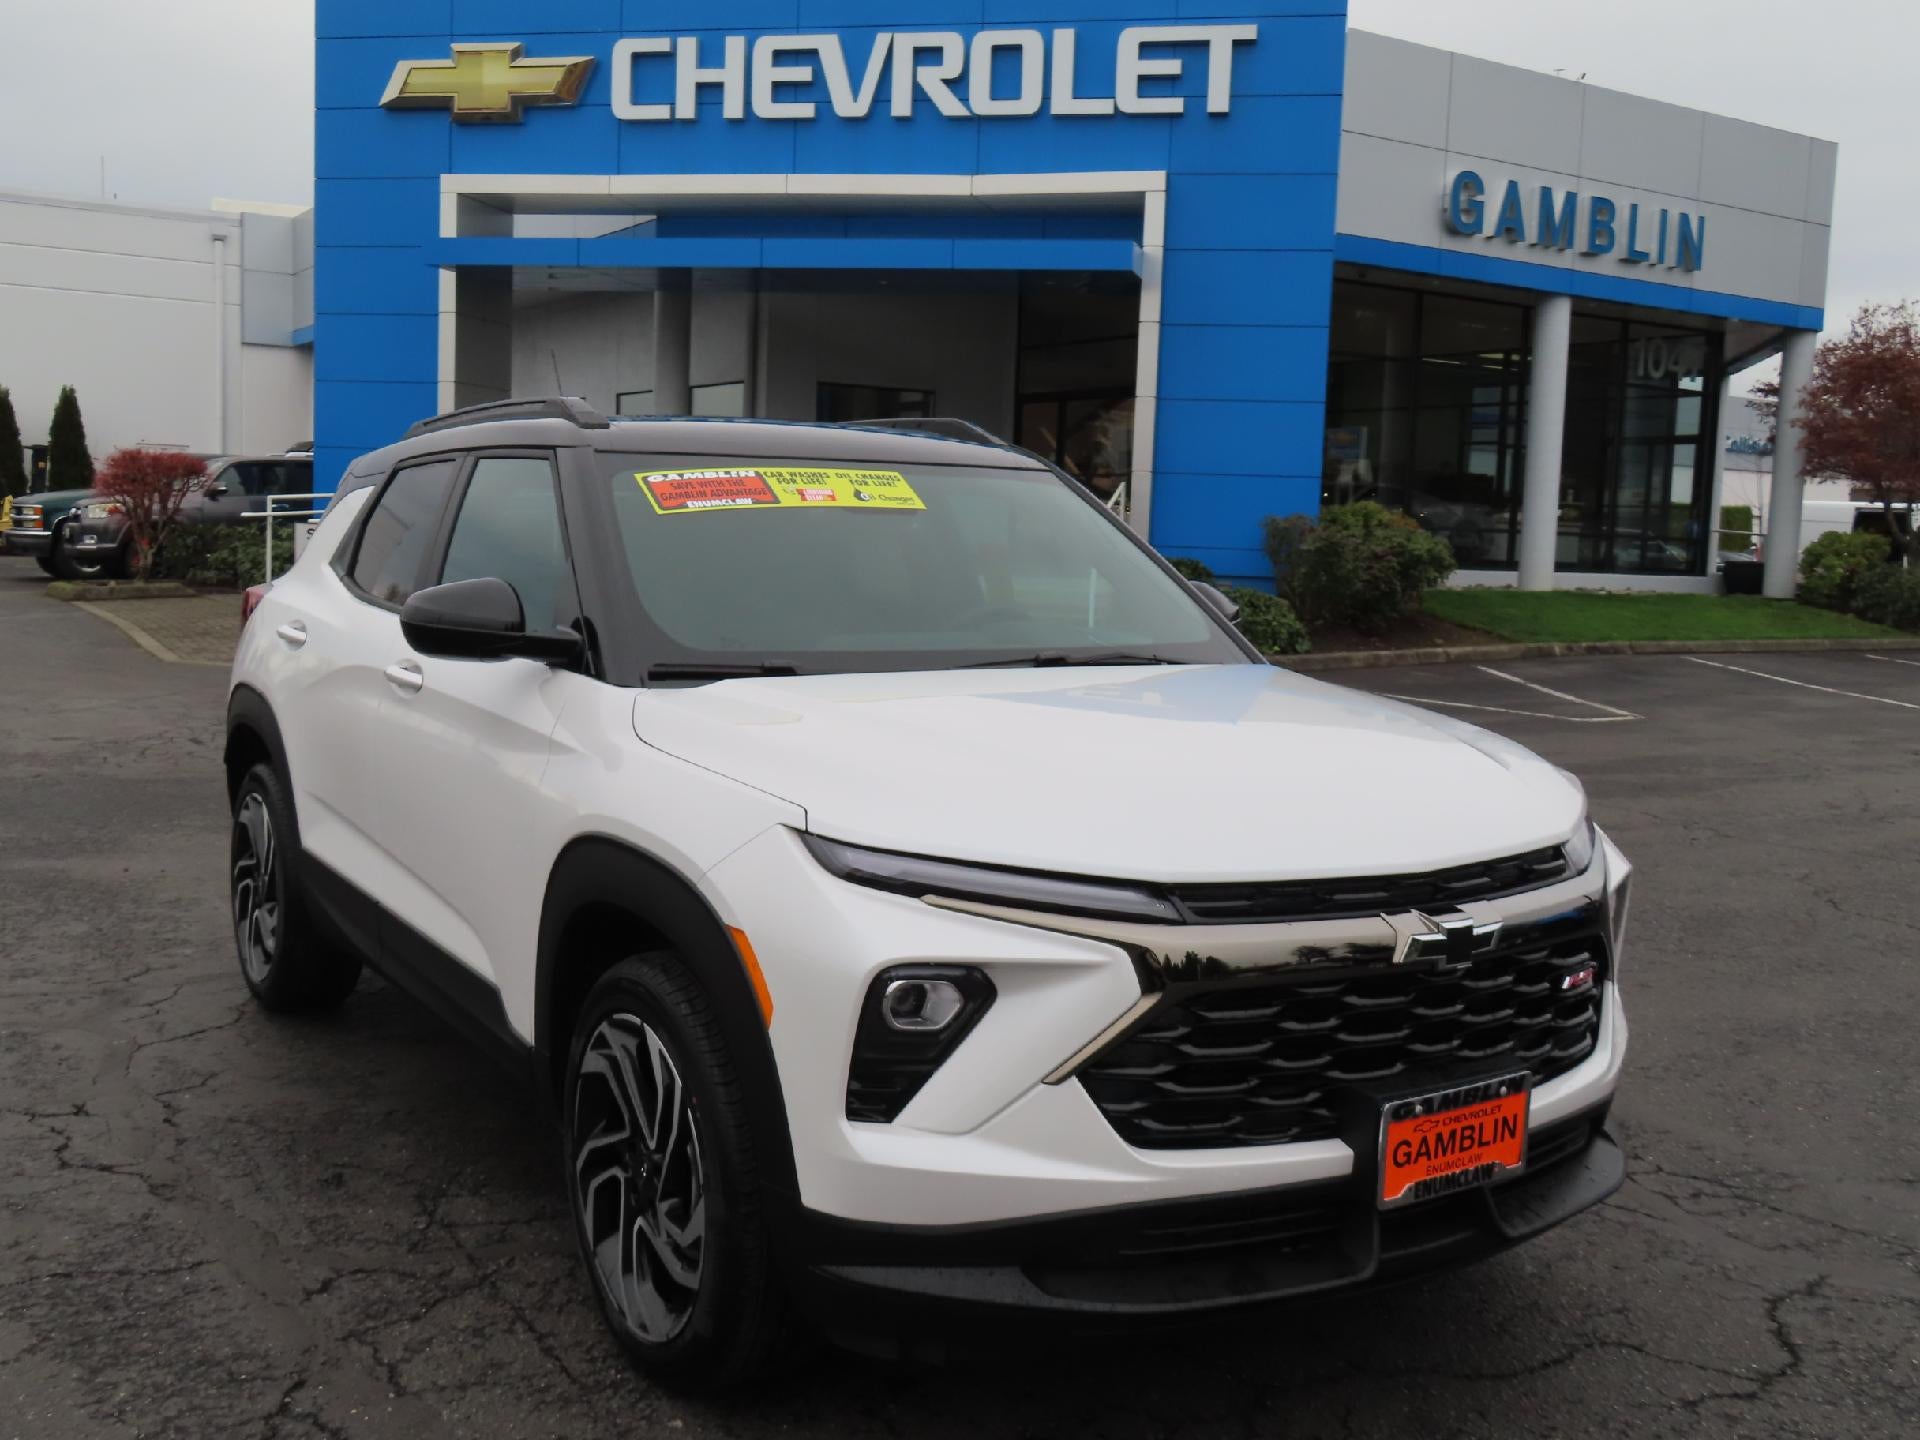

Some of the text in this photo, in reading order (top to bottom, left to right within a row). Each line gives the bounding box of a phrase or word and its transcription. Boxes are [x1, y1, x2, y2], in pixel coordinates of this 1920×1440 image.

[611, 24, 1257, 121] CHEVROLET
[1447, 170, 1705, 272] GAMBLIN
[647, 470, 756, 482] GAMBLIN
[763, 471, 830, 479] CAR WASHES
[855, 473, 901, 482] CHANGES
[670, 479, 745, 490] SAVE WITH THE
[850, 479, 871, 487] FOR
[660, 487, 768, 502] GAMBLIN ADVANTAGE
[686, 498, 752, 508] ENUMCLAW
[1442, 1104, 1503, 1126] CHEVROLET
[1393, 1113, 1518, 1168] GAMBLIN
[1426, 1153, 1483, 1176] ENUMCLAW
[1414, 1162, 1495, 1199] ENUMCLAW
